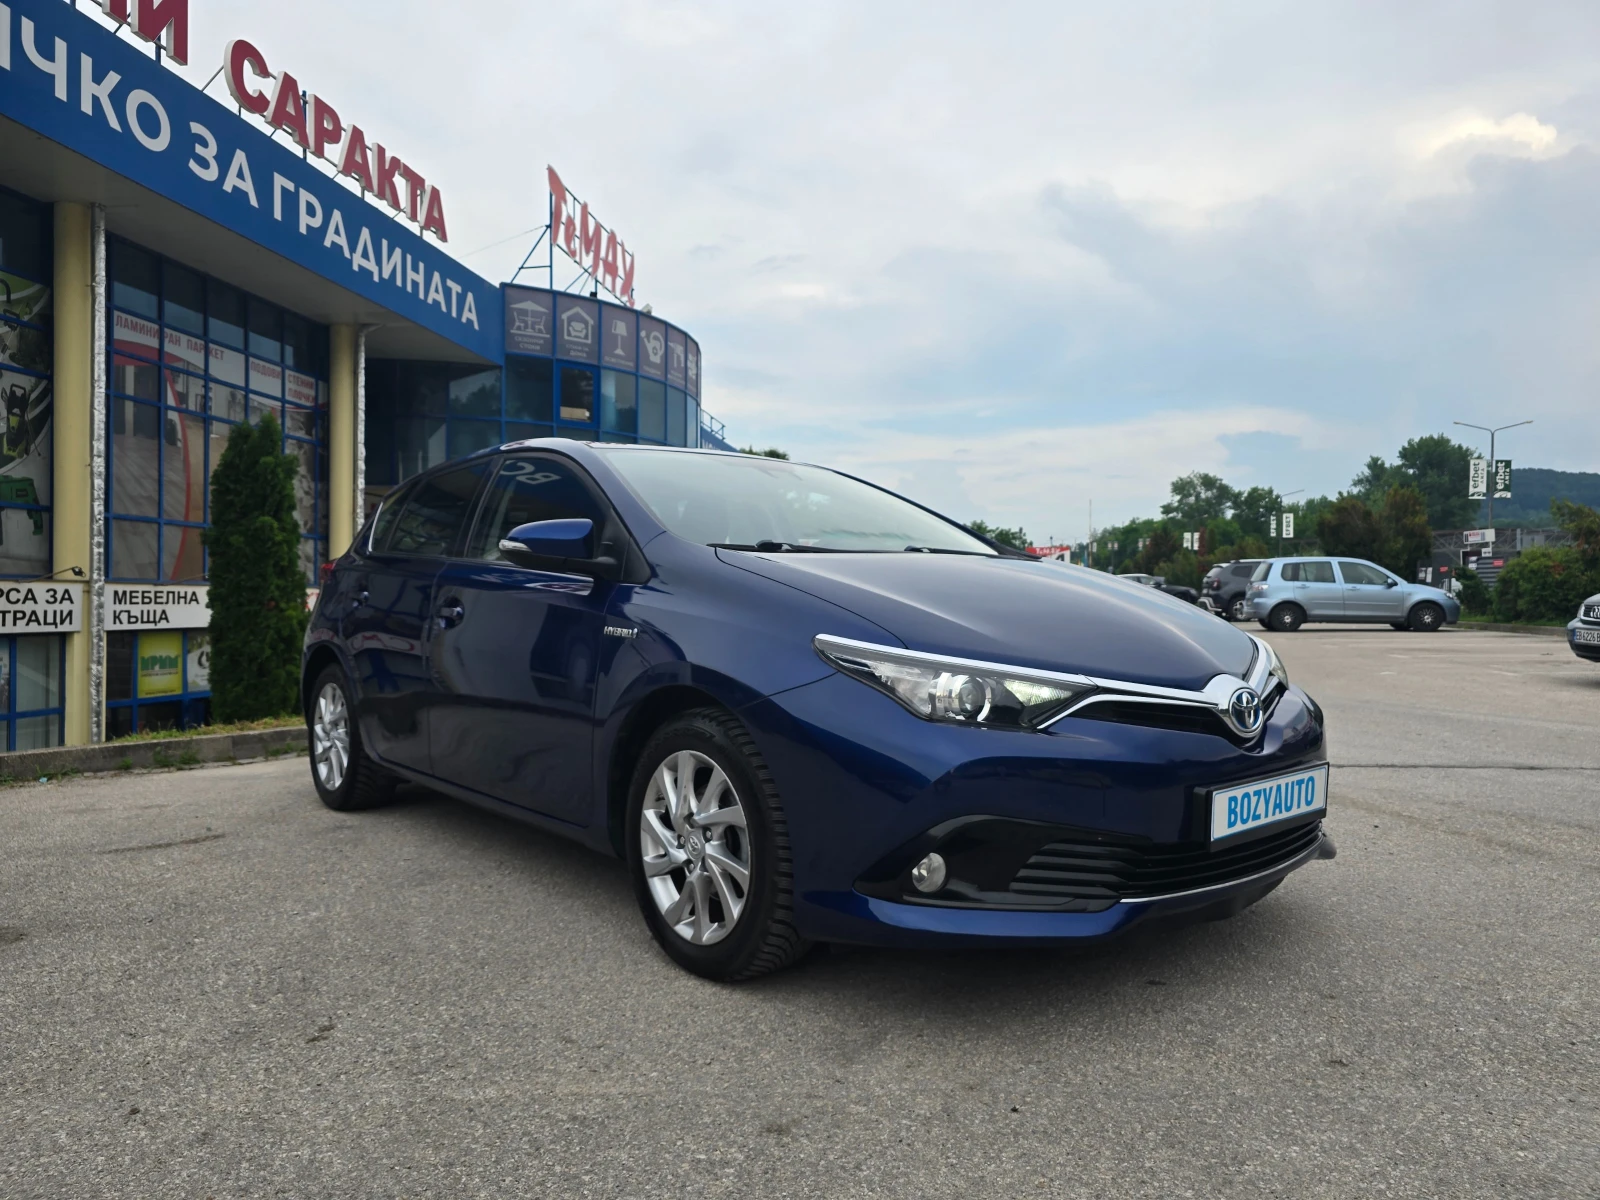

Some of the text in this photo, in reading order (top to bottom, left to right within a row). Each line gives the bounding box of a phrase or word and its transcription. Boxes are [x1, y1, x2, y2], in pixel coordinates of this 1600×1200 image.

[224, 39, 448, 243] САРАКТА
[188, 120, 259, 209] ЗА
[273, 171, 479, 331] ГРАДИНАТА
[1471, 461, 1480, 489] efbet
[1496, 461, 1506, 490] efbet
[45, 588, 74, 605] ЗА
[113, 589, 199, 606] МЕБЕЛНА
[113, 609, 170, 626] КЪЩА
[1227, 775, 1315, 829] BOZYAUTO
